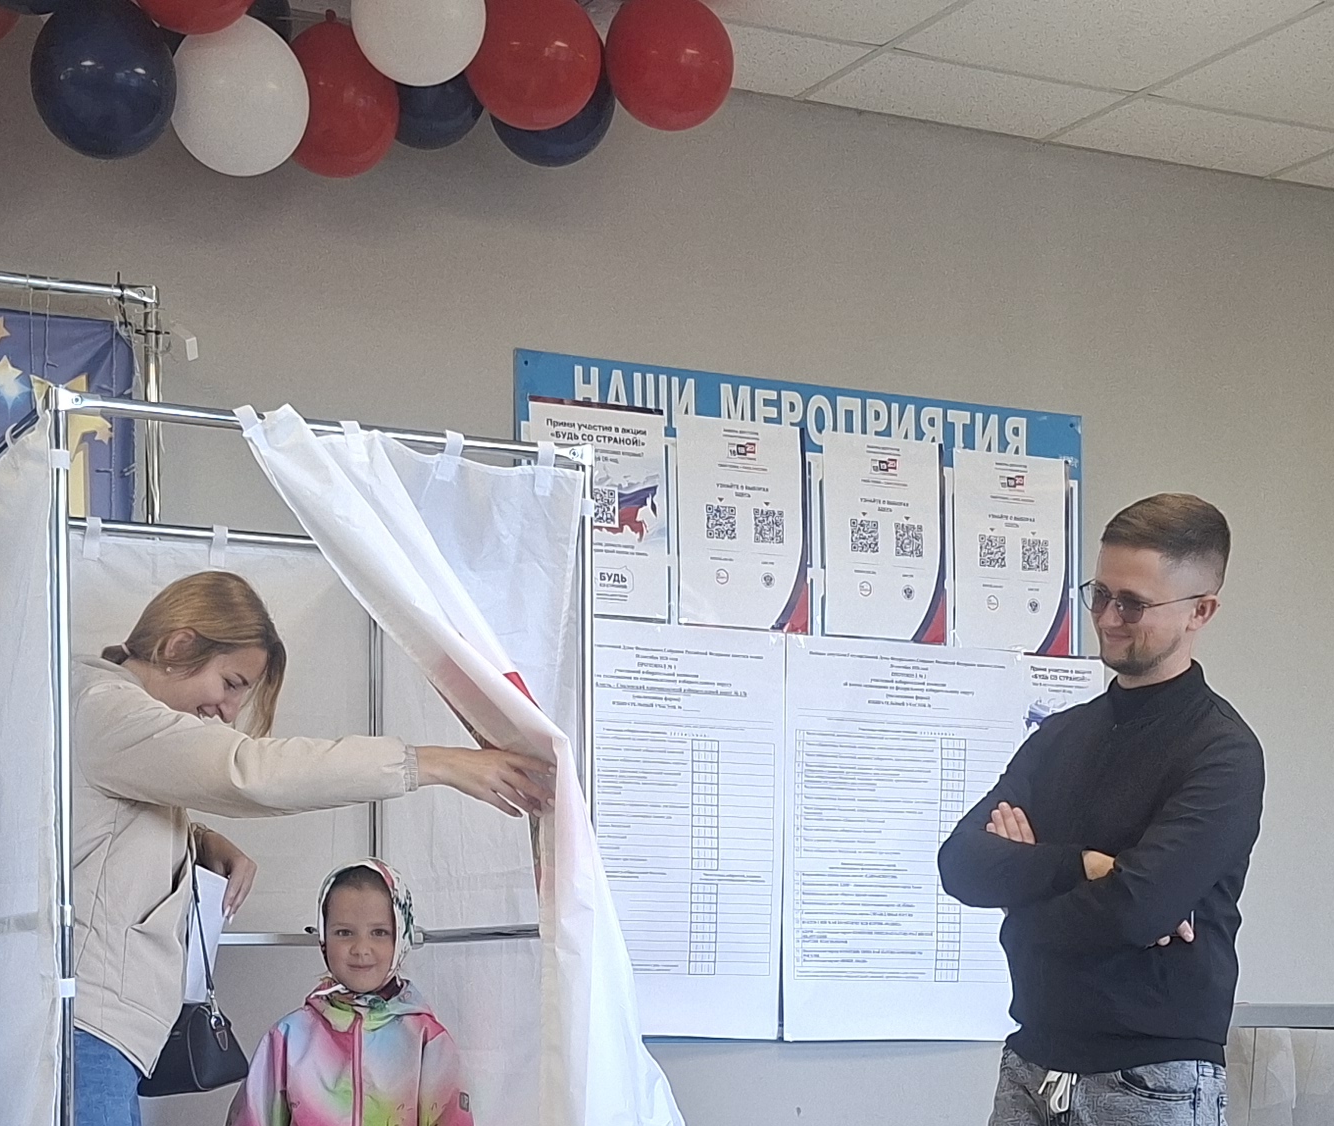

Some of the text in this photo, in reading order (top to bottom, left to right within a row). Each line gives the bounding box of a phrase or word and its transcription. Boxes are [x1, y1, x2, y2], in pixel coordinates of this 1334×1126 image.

[574, 364, 1027, 456] НАШИ МЕРОПРИЯТИЯ
[551, 431, 579, 441] «БУДЬ
[581, 433, 594, 442] СО
[599, 572, 627, 583] БУДЬ
